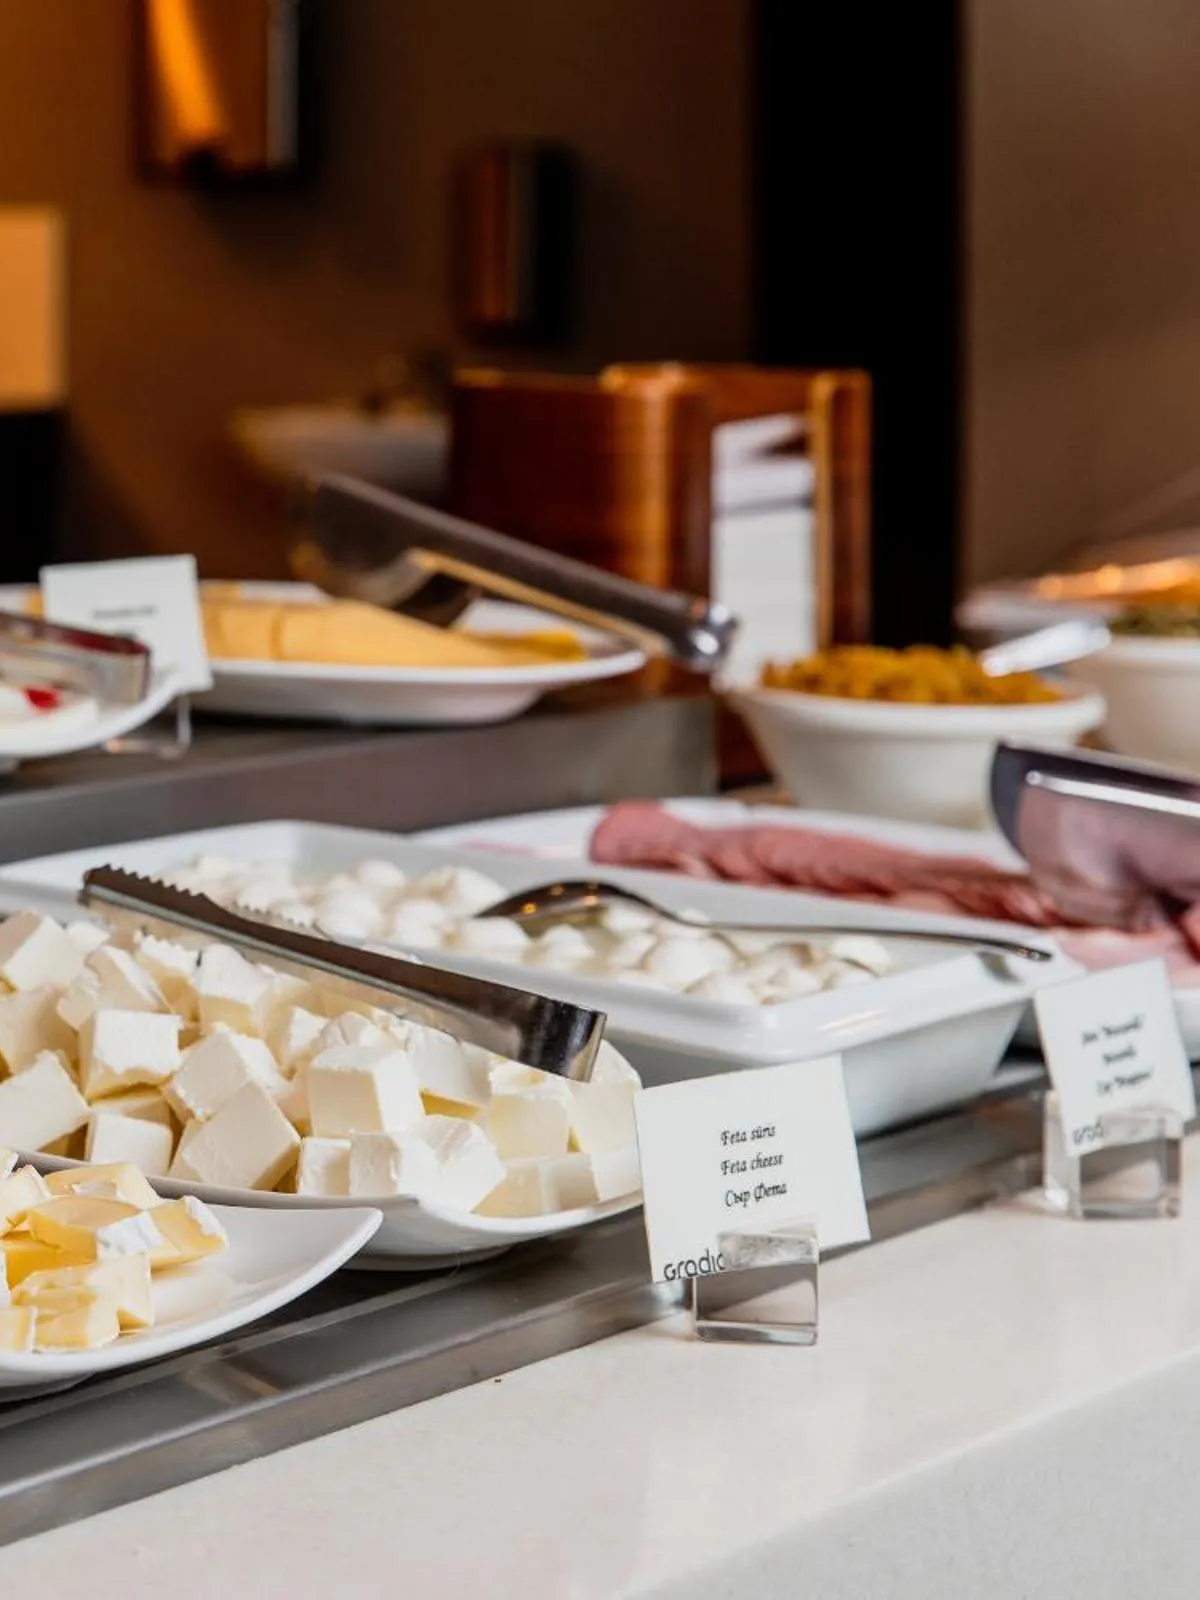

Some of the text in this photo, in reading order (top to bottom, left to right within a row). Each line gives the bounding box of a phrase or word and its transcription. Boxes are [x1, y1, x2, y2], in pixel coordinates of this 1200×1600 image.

[720, 1130, 748, 1146] Feta
[720, 1152, 784, 1176] Feta cheese
